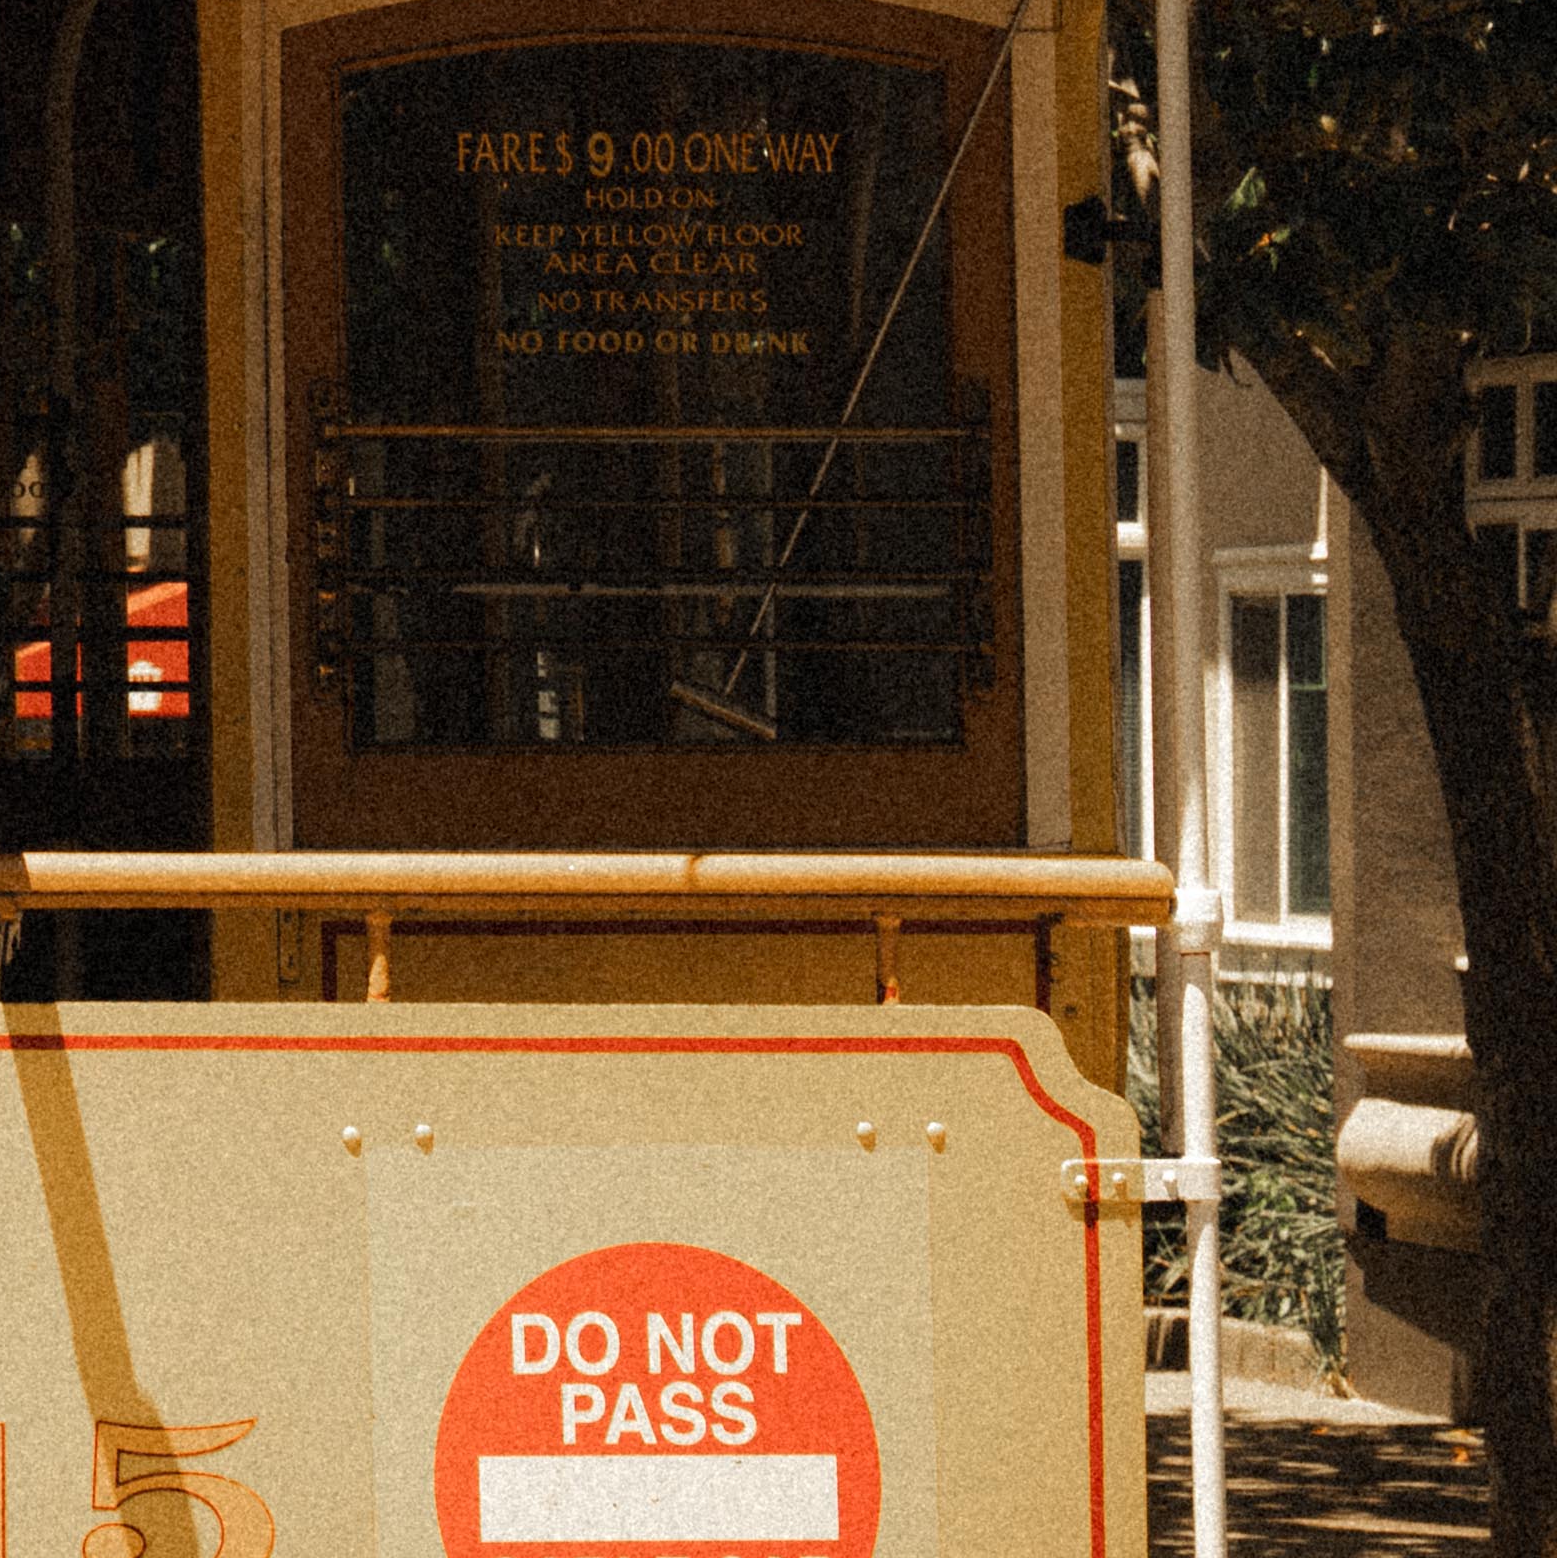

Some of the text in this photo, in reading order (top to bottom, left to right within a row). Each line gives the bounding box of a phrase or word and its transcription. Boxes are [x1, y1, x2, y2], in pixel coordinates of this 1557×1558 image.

[457, 132, 547, 174] FARE
[684, 132, 758, 173] ONE
[765, 133, 840, 173] WAY
[585, 187, 717, 209] HOLD ON
[494, 224, 803, 248] KEEP YELLOW FLOOR
[544, 252, 758, 275] AREA CLEAR
[538, 290, 768, 314] NO TRANSFERS
[496, 331, 810, 355] NO FOOD OR DRINK
[510, 1310, 803, 1376] DO NOT
[561, 1381, 757, 1446] PASS
